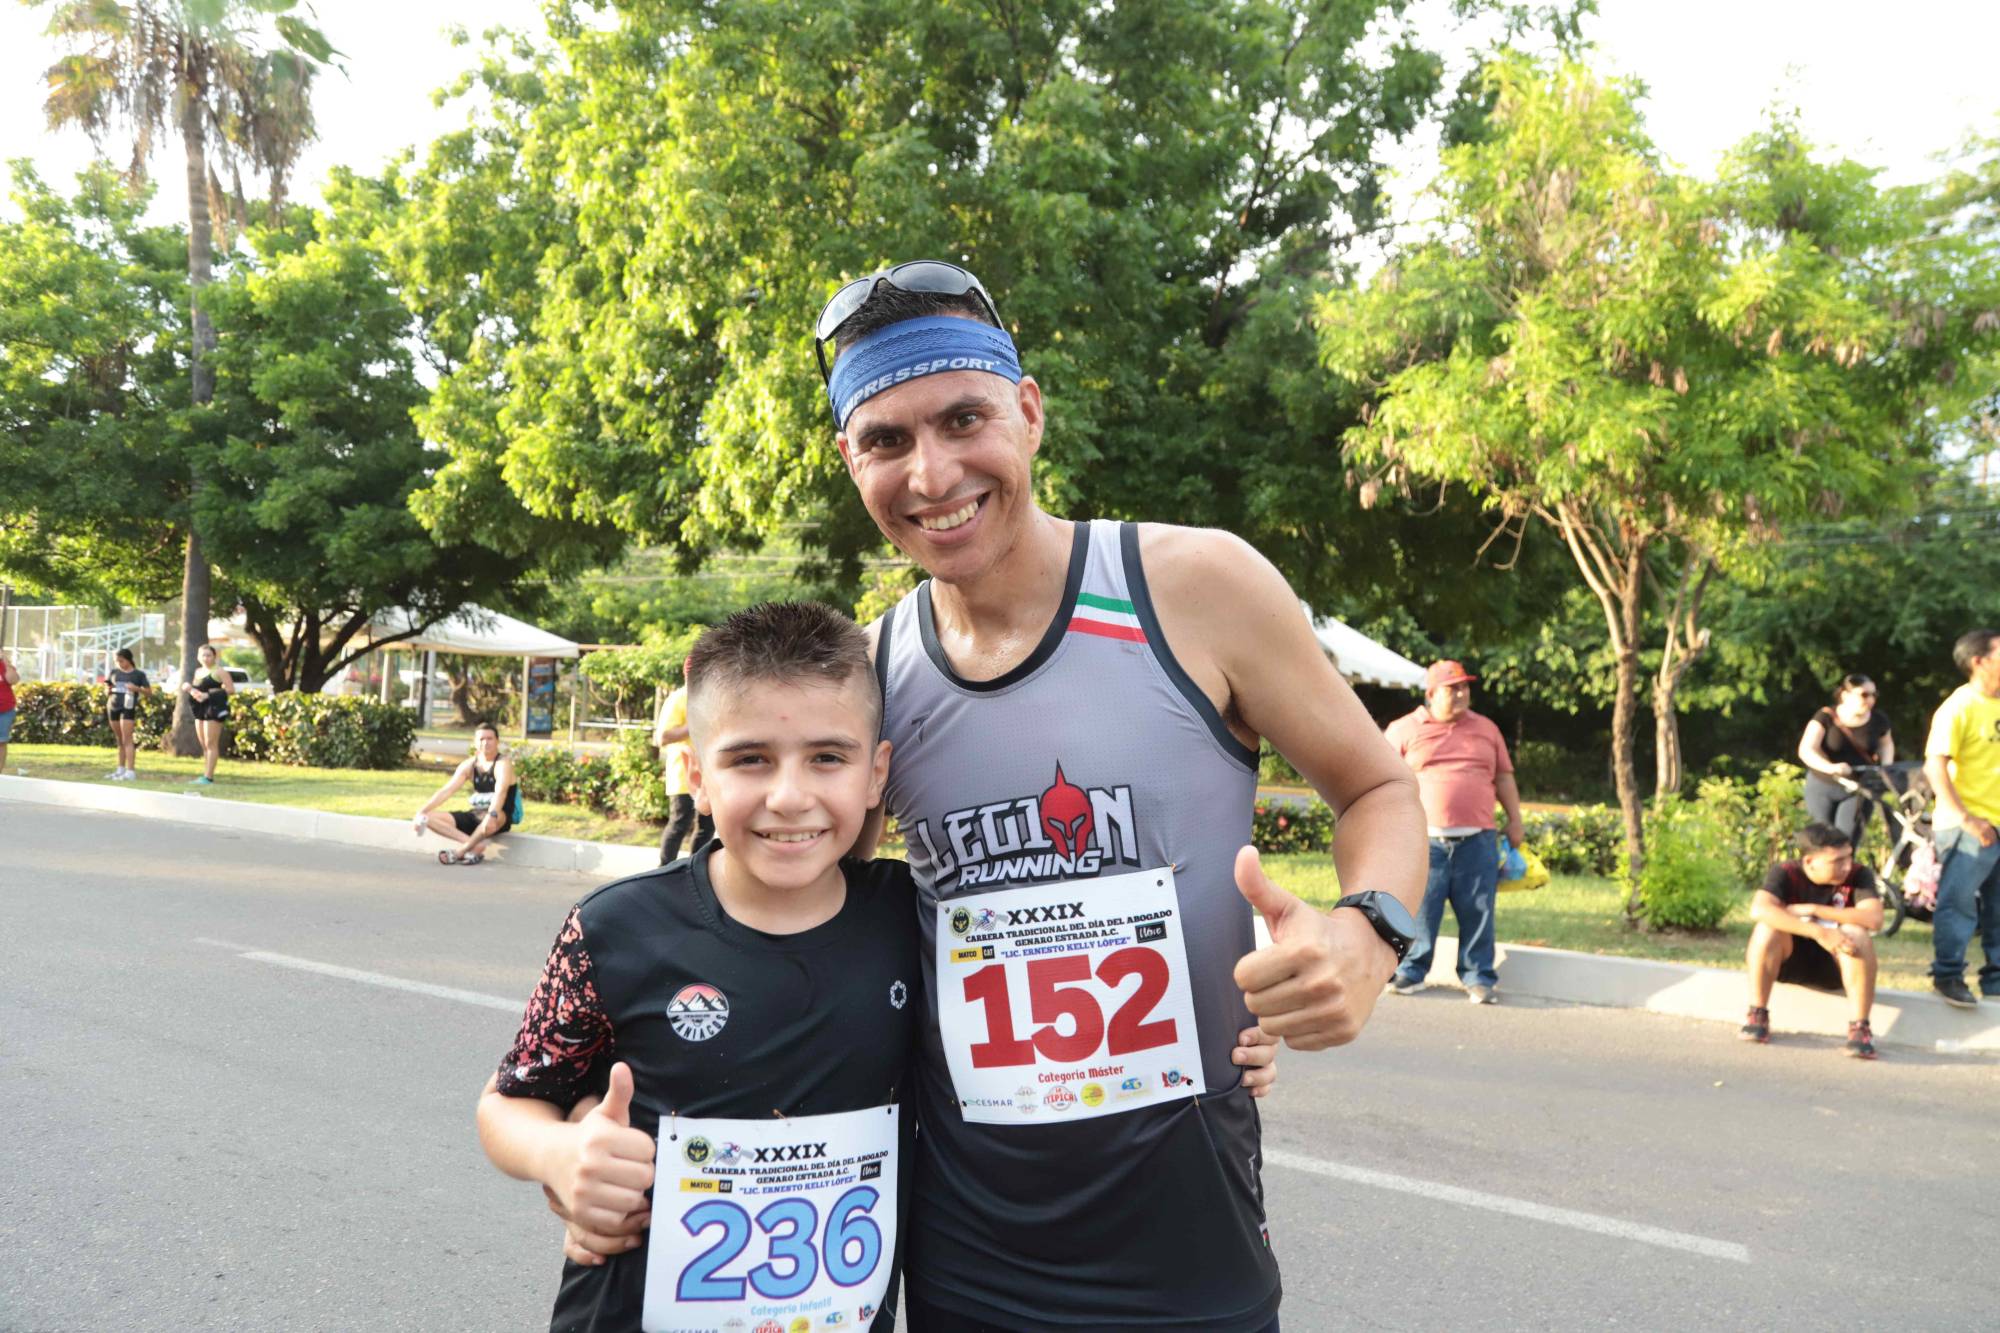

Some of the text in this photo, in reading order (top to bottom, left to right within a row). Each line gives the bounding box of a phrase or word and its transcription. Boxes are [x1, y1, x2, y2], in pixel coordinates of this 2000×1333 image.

[958, 850, 1102, 888] RUNNING
[1007, 902, 1085, 926] XXXIX
[965, 932, 1005, 943] CARRERA
[1006, 925, 1068, 938] TRADICIONAL
[1069, 922, 1087, 931] DEL
[1107, 918, 1124, 927] DEL
[1126, 910, 1172, 924] ABOGADO
[1015, 928, 1119, 947] GENARO ESTRADA A.C.
[1023, 945, 1065, 957] ERNESTO
[1066, 940, 1095, 952] KELLY
[962, 946, 1179, 1069] 152
[670, 1014, 727, 1040] MANIACOS
[976, 1098, 1013, 1107] CESMAR
[702, 1167, 746, 1175] CARRERA
[749, 1164, 809, 1175] TRADICIONAL
[811, 1162, 826, 1170] DEL
[842, 1158, 855, 1166] DEL
[857, 1150, 889, 1163] ABOGADO
[754, 1142, 827, 1163] XXXIX
[690, 1181, 712, 1189] MATCO
[756, 1174, 793, 1184] GENARO
[796, 1169, 834, 1181] ESTRADA
[762, 1184, 803, 1194] ERNESTO
[805, 1180, 830, 1190] KELLY
[675, 1185, 882, 1302] 236
